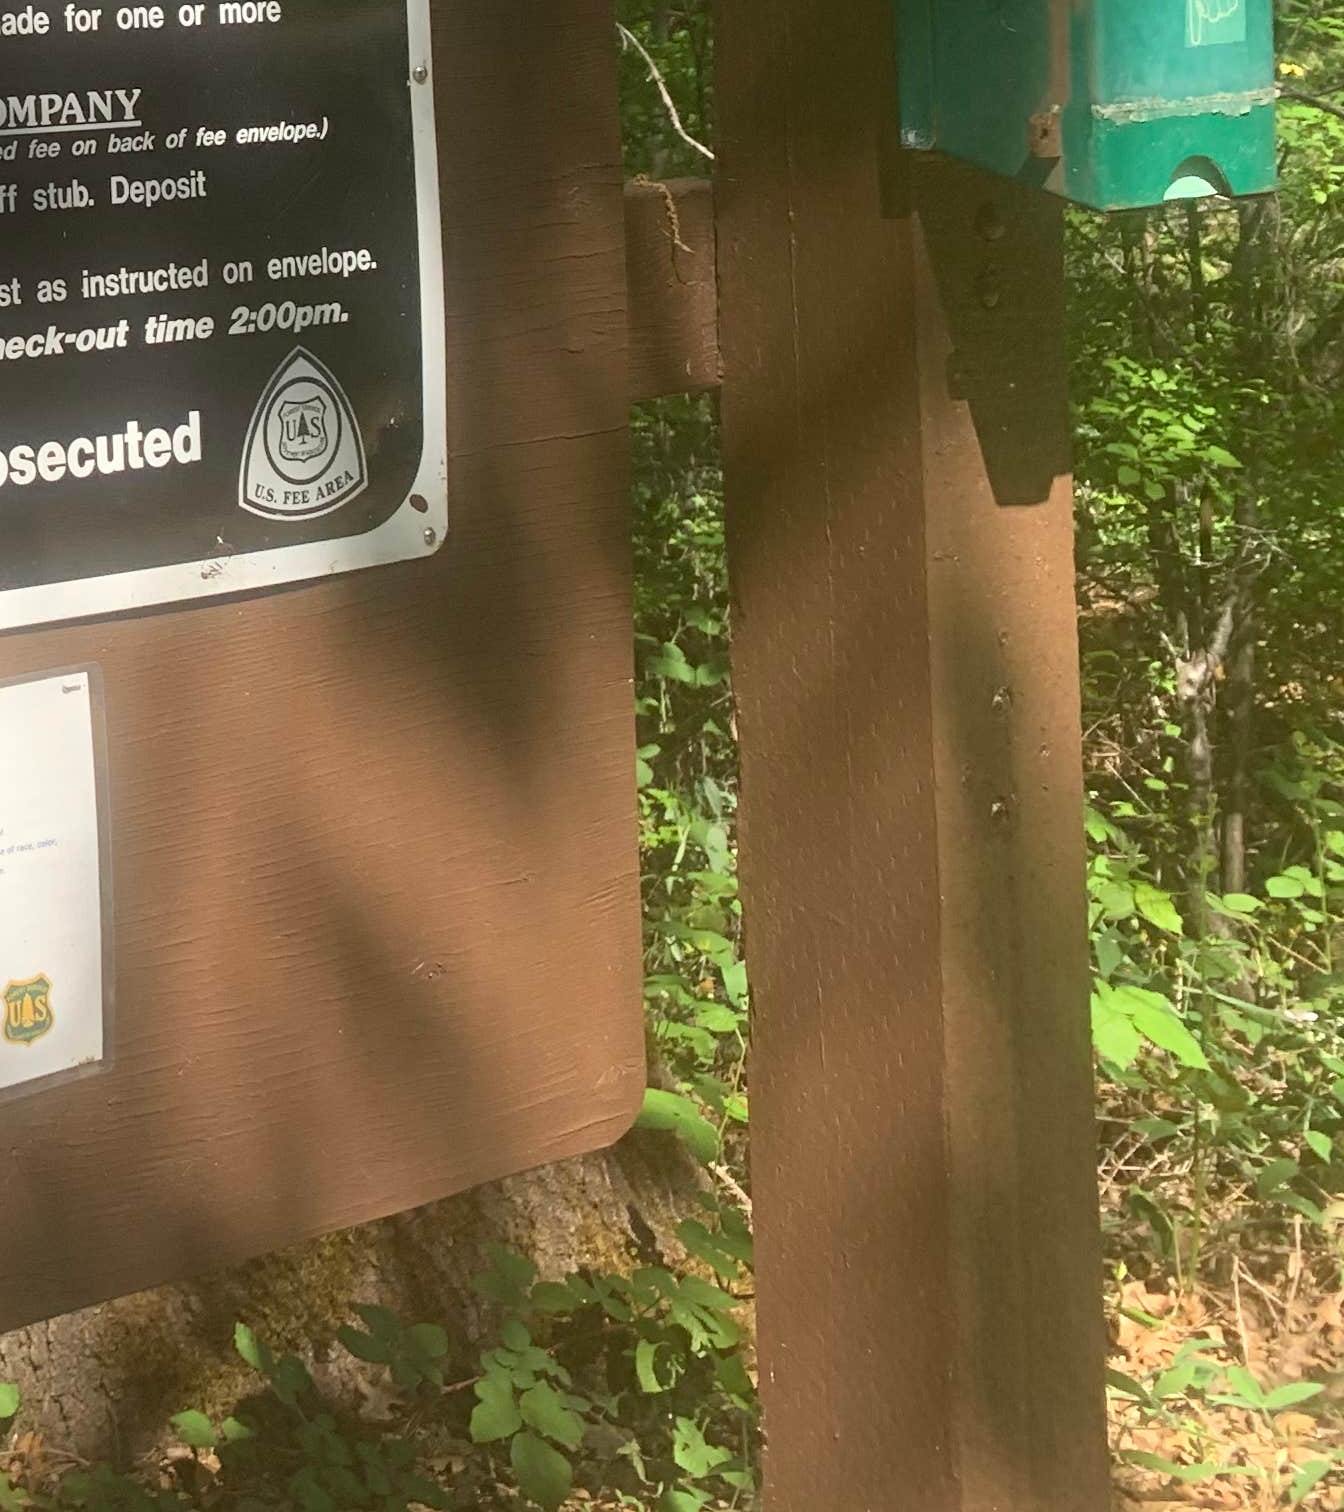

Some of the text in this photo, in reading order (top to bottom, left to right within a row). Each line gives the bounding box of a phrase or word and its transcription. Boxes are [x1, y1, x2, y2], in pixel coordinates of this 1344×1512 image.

[255, 470, 354, 505] U.S. FEE AREA
